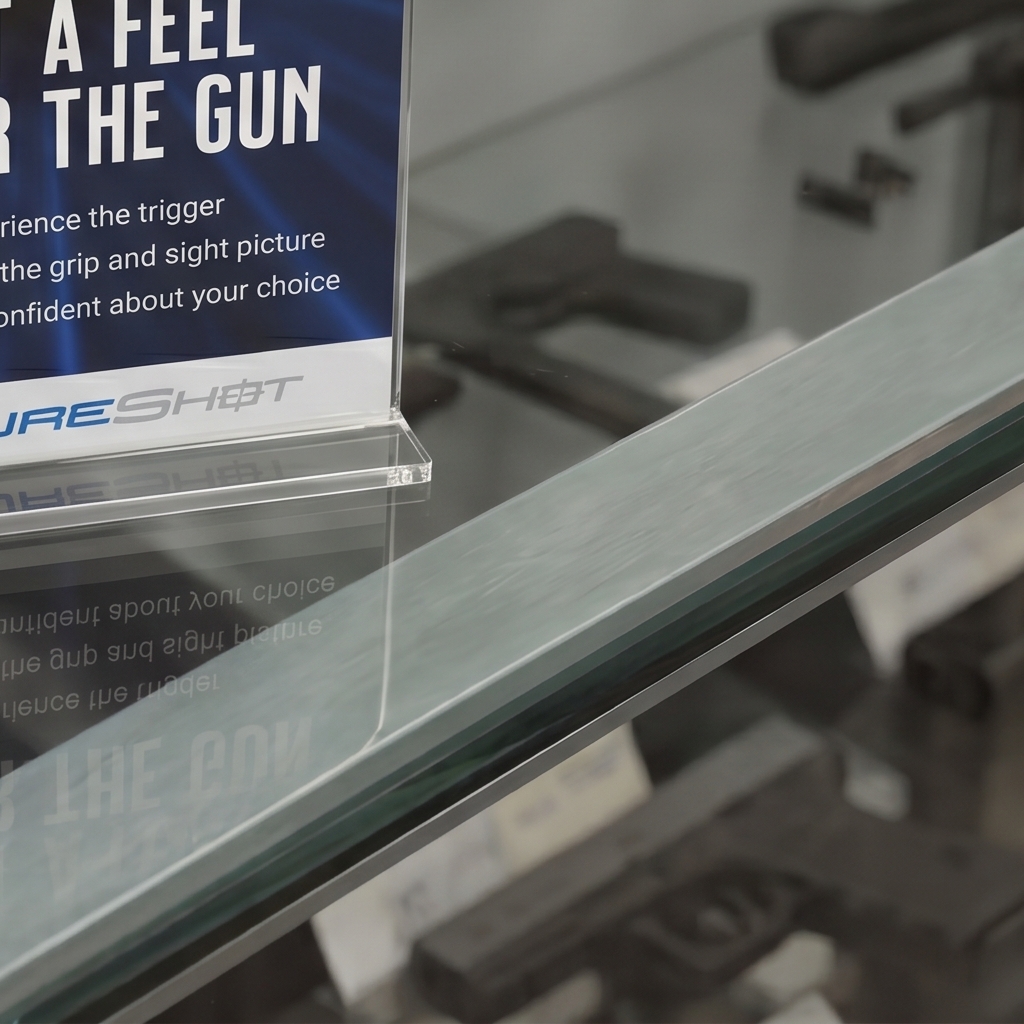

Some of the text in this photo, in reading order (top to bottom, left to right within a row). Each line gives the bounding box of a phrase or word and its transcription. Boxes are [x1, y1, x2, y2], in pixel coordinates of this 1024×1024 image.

[43, 80, 165, 169] THE
[195, 65, 321, 154] GUN
[88, 204, 131, 228] the
[138, 197, 226, 226] trigger
[0, 258, 42, 283] the
[50, 252, 100, 283] grip
[109, 243, 156, 271] and
[165, 238, 229, 268] sight
[237, 232, 326, 264] picture
[109, 287, 184, 315] about
[191, 283, 249, 312] your
[256, 271, 341, 298] choice
